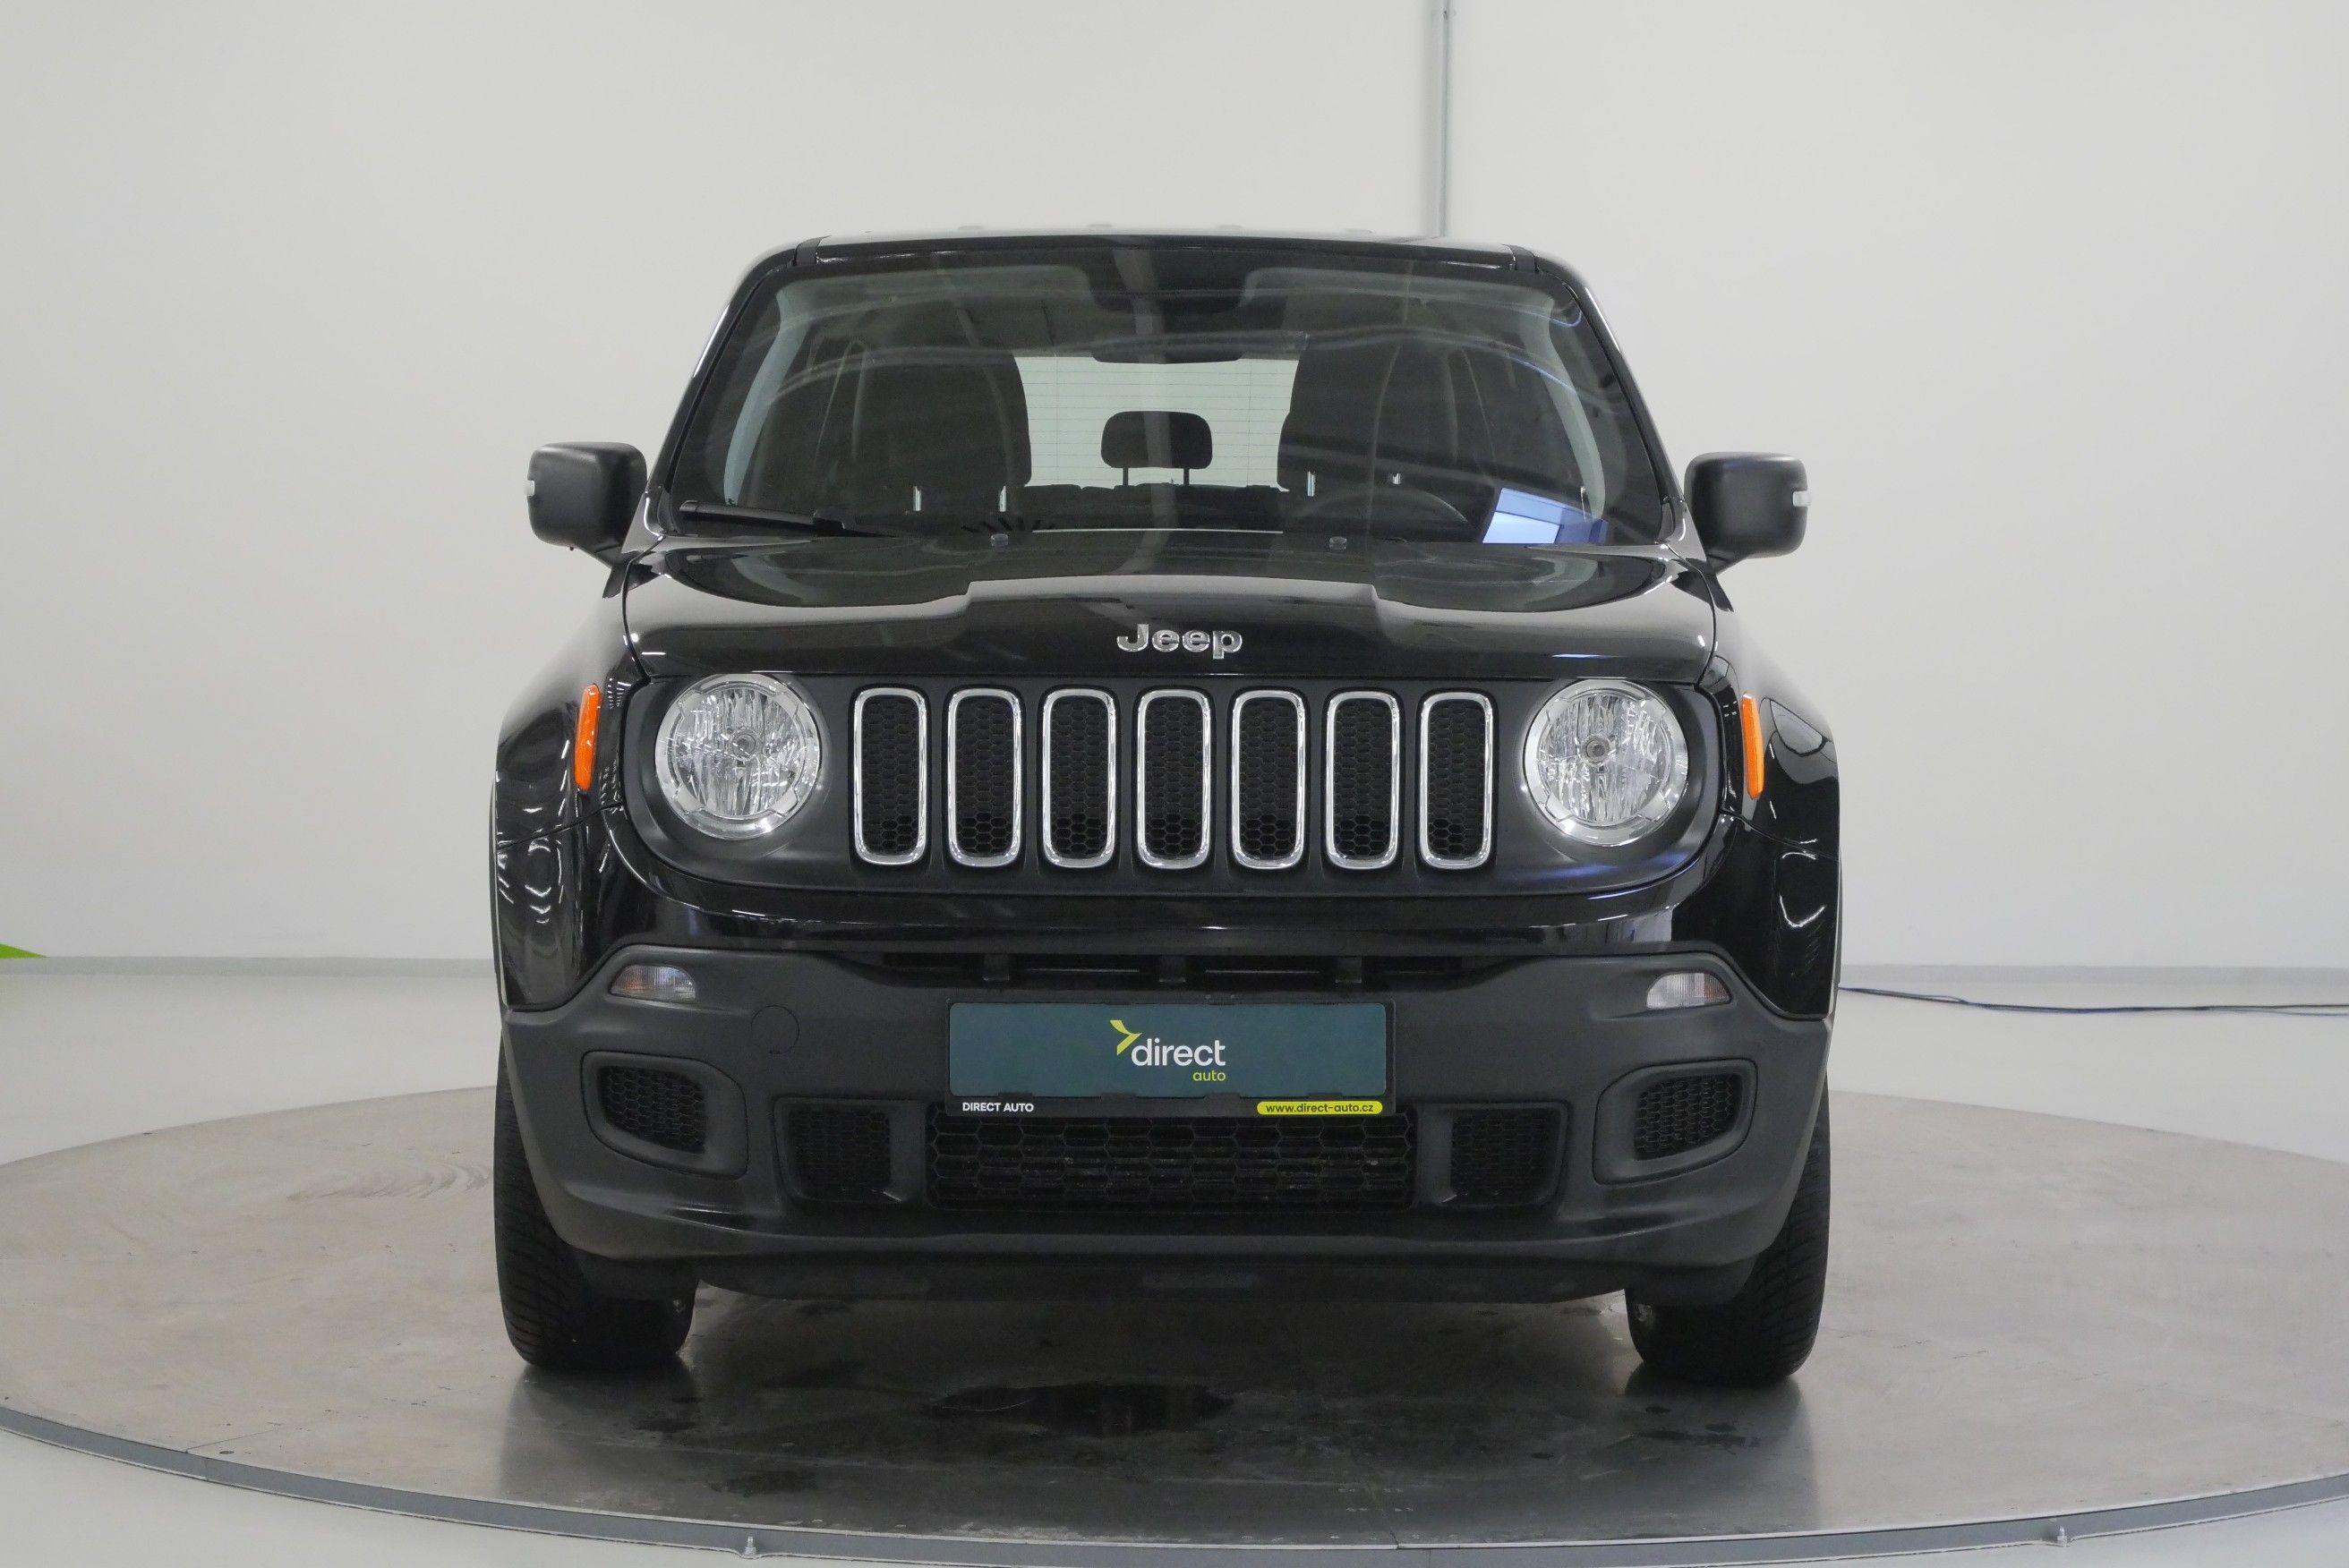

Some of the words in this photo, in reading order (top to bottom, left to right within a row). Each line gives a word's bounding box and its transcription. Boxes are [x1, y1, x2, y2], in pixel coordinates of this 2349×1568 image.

[1116, 624, 1243, 660] Jeep
[1131, 1037, 1226, 1067] direct
[1192, 1069, 1226, 1082] auto
[962, 1102, 1001, 1112] DIRECT
[1003, 1103, 1035, 1112] AUTO
[1265, 1104, 1374, 1112] www.direct-auto.cz
